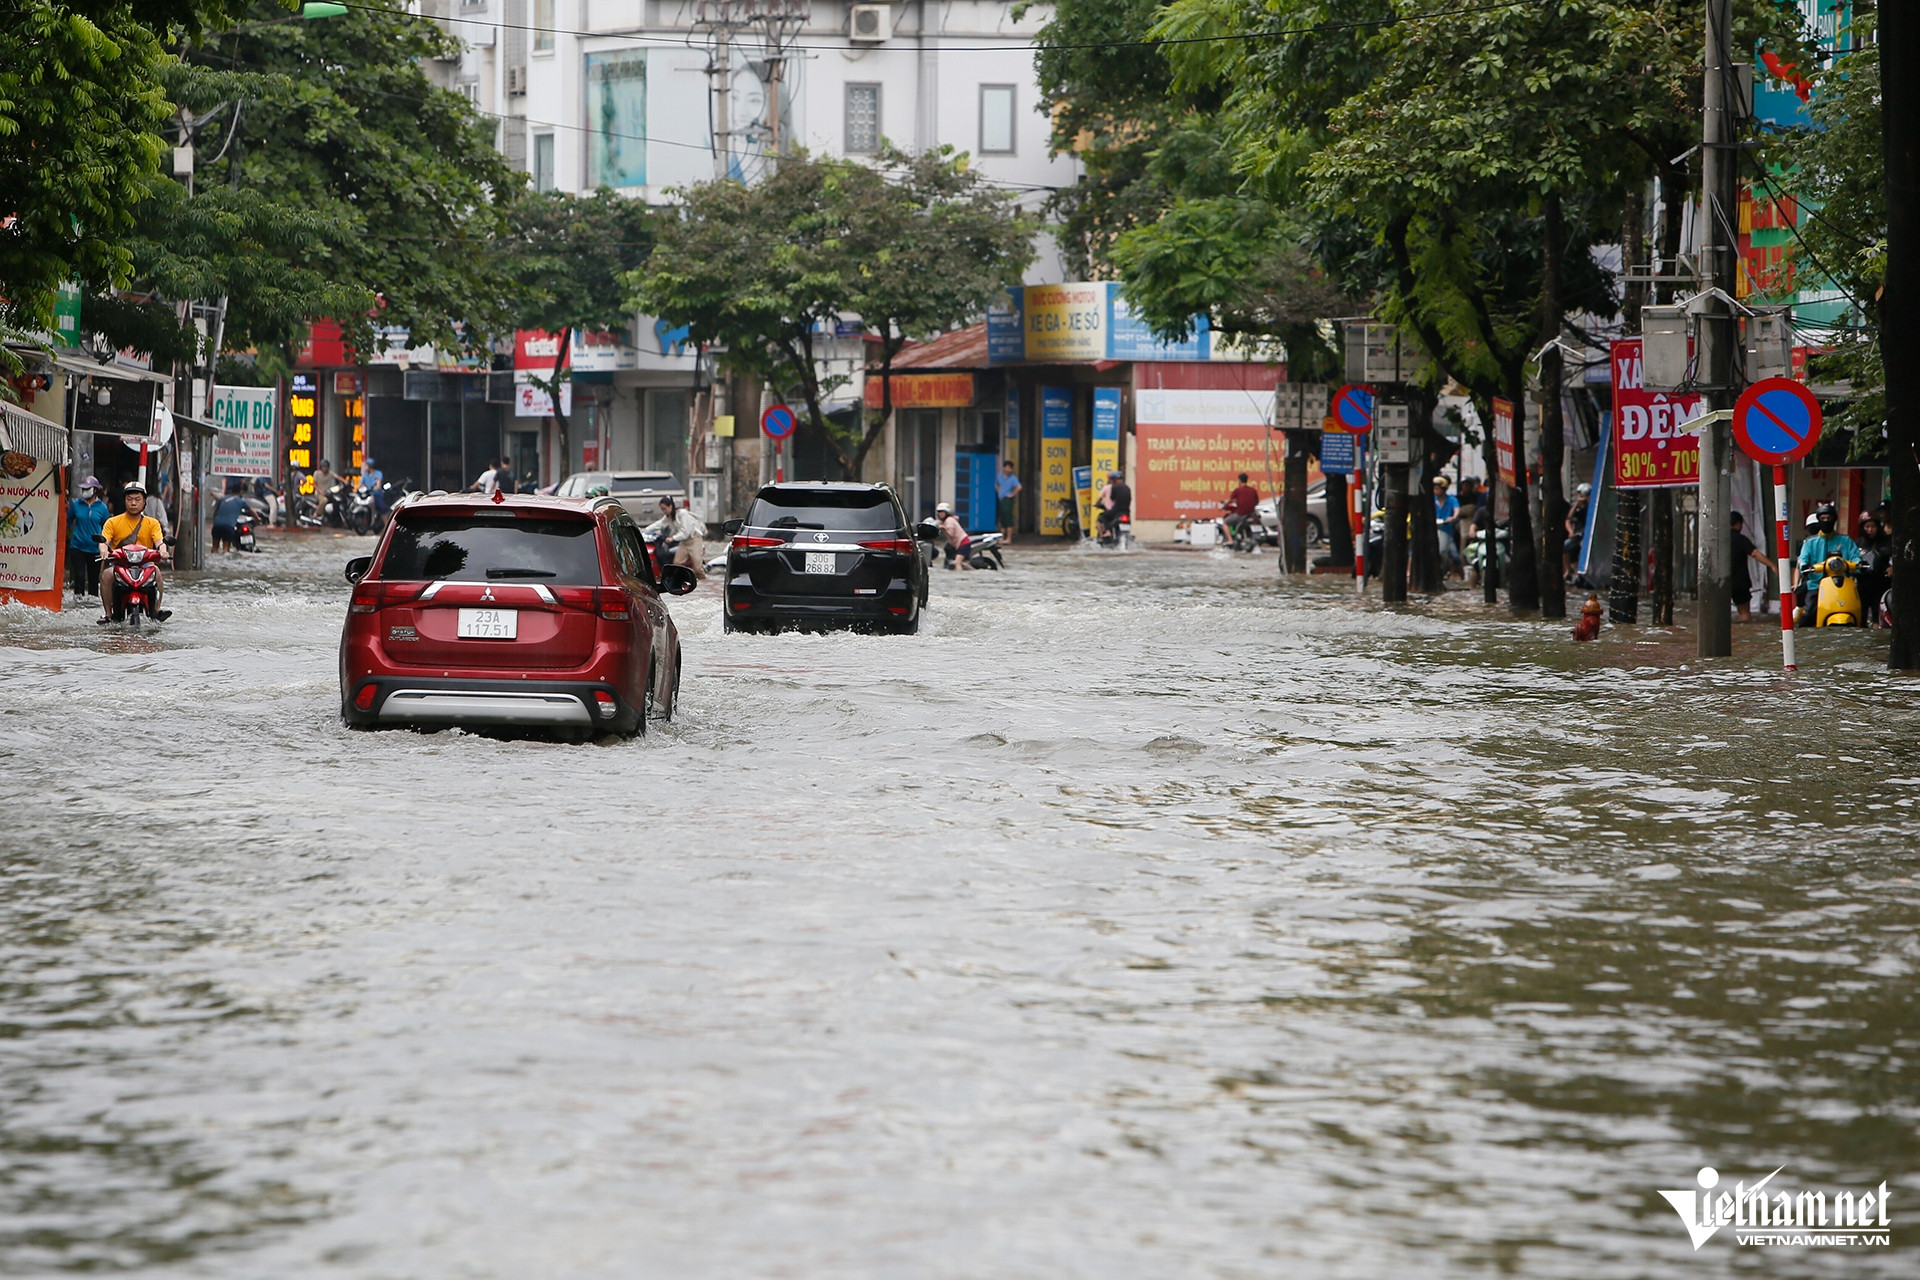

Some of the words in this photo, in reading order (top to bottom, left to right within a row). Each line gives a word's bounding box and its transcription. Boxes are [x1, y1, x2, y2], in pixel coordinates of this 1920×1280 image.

[1030, 313, 1043, 332] XE
[1045, 312, 1060, 331] GA
[1069, 311, 1082, 330] XE
[1084, 303, 1100, 330] SỐ
[215, 389, 248, 429] CẦM
[253, 391, 273, 430] ĐỒ
[1097, 459, 1113, 471] XE
[1621, 452, 1656, 477] 30%
[38, 489, 50, 500] HQ
[812, 553, 829, 563] 30G
[806, 564, 835, 573] 268.82
[19, 573, 42, 584] sáng
[475, 611, 500, 623] 23A
[466, 624, 509, 636] 117.51
